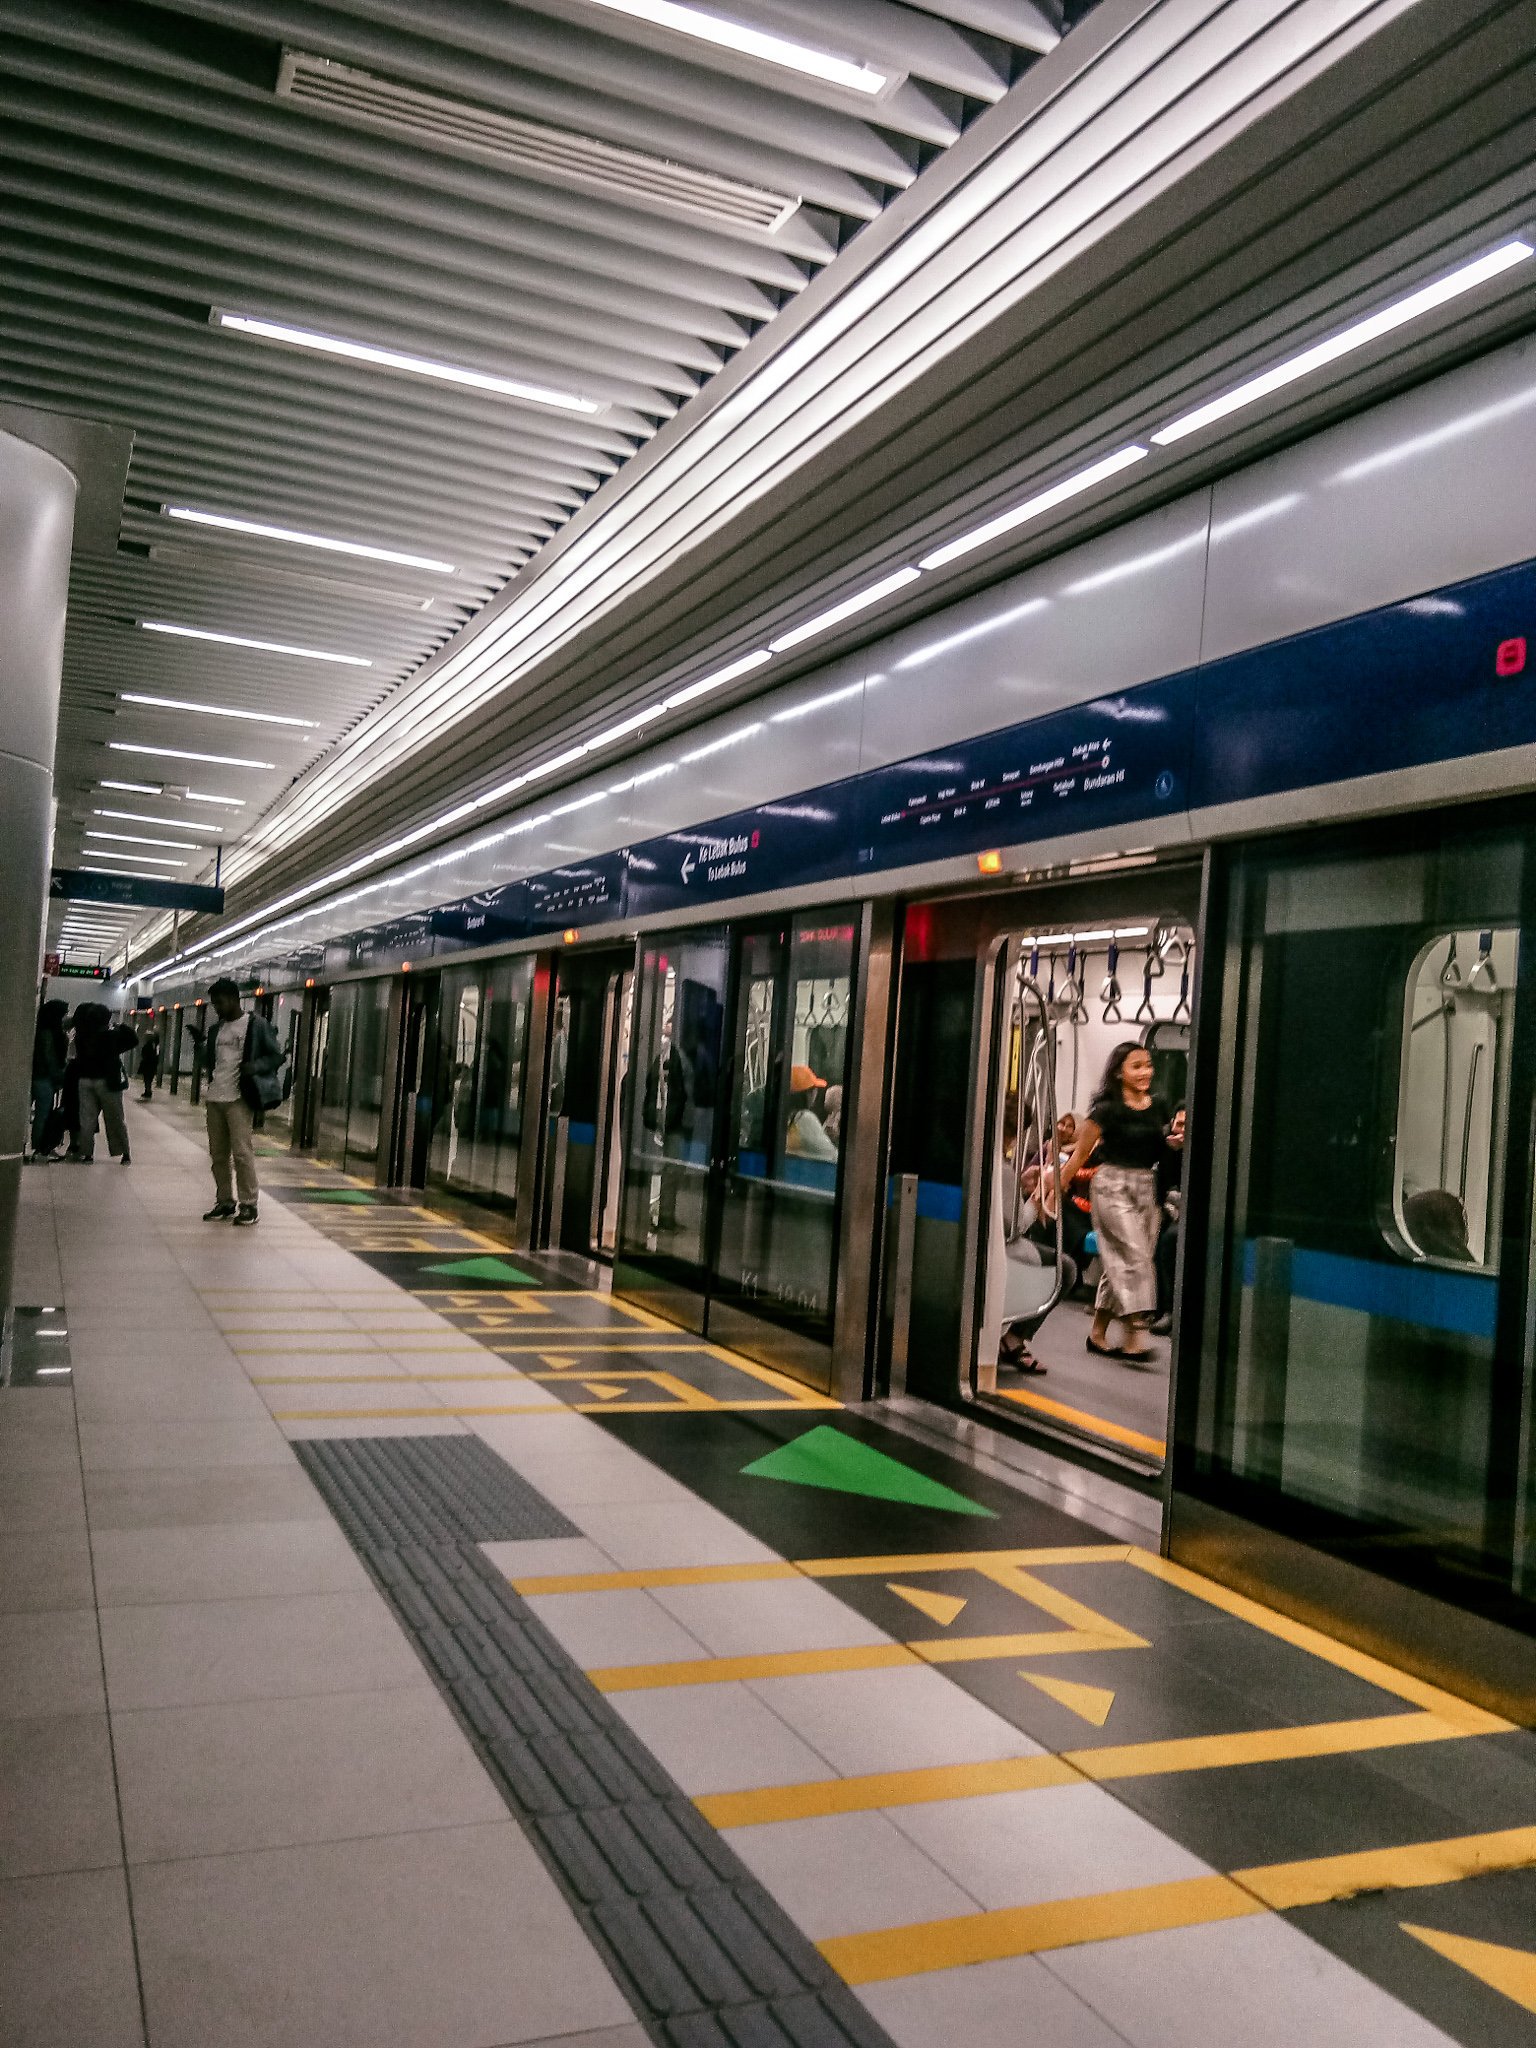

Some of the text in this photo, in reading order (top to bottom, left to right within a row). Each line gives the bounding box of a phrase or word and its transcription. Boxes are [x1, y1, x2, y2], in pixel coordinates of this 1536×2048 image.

[1083, 773, 1115, 792] Bundaran
[698, 834, 748, 864] Ke Lebak Bulus
[715, 863, 730, 881] Lebak
[730, 860, 746, 877] Bulus
